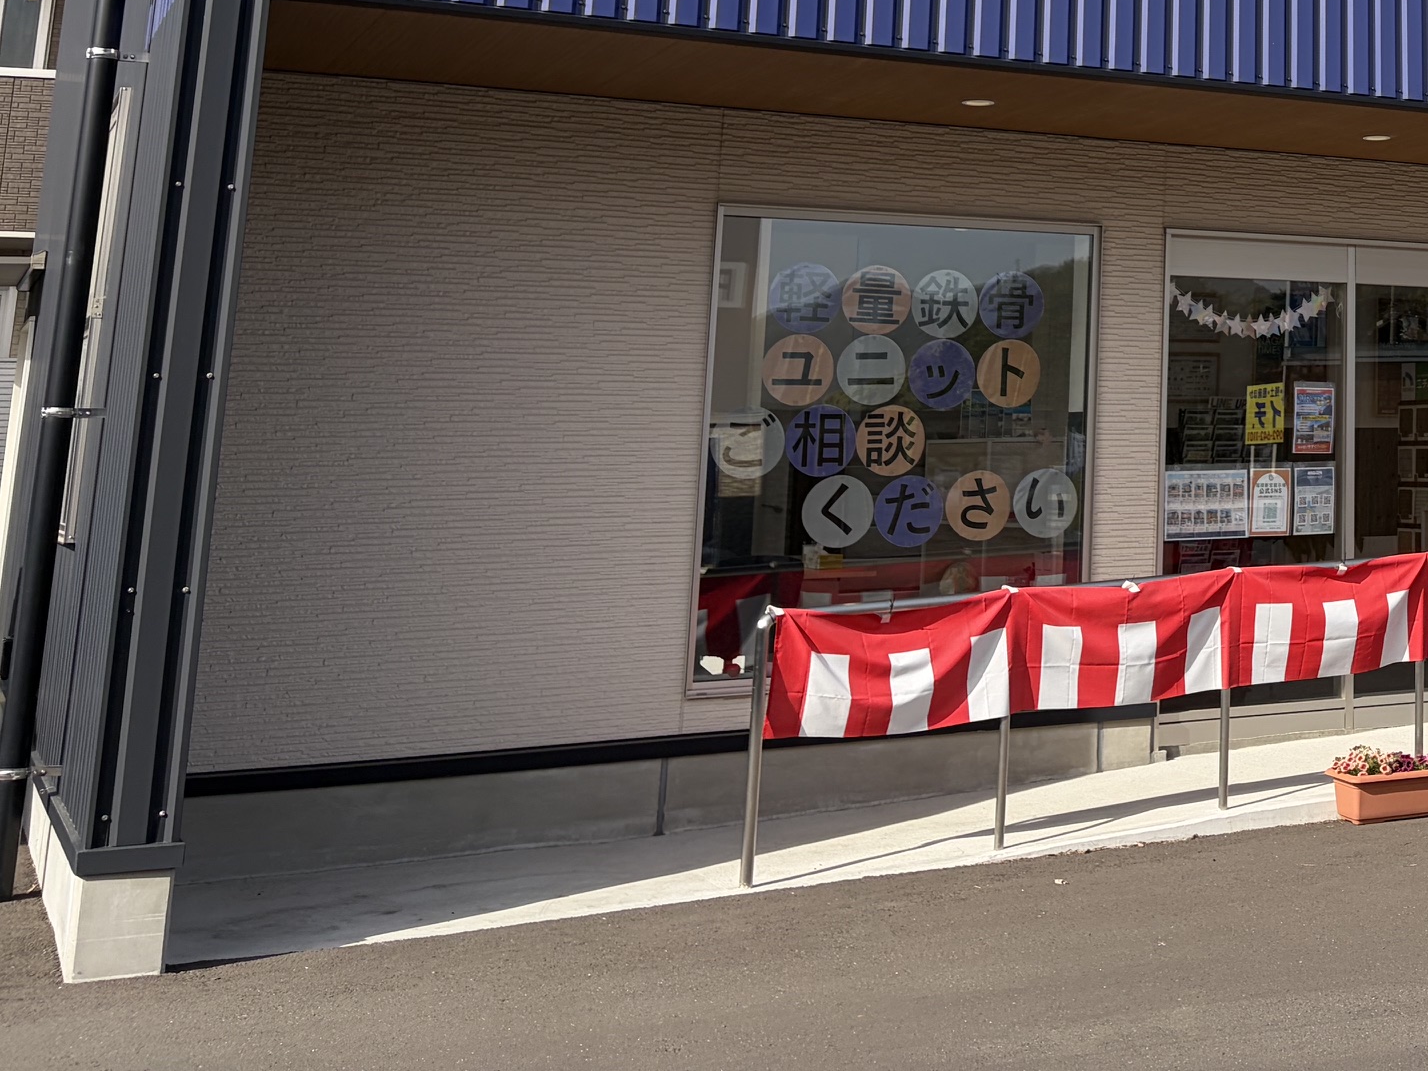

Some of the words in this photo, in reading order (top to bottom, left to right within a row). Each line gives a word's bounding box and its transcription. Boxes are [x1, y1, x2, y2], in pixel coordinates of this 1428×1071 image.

[778, 270, 1034, 329] 軽量鉄骨
[771, 348, 1025, 400] ユニット
[722, 411, 916, 469] ご相談
[821, 477, 1065, 536] ください
